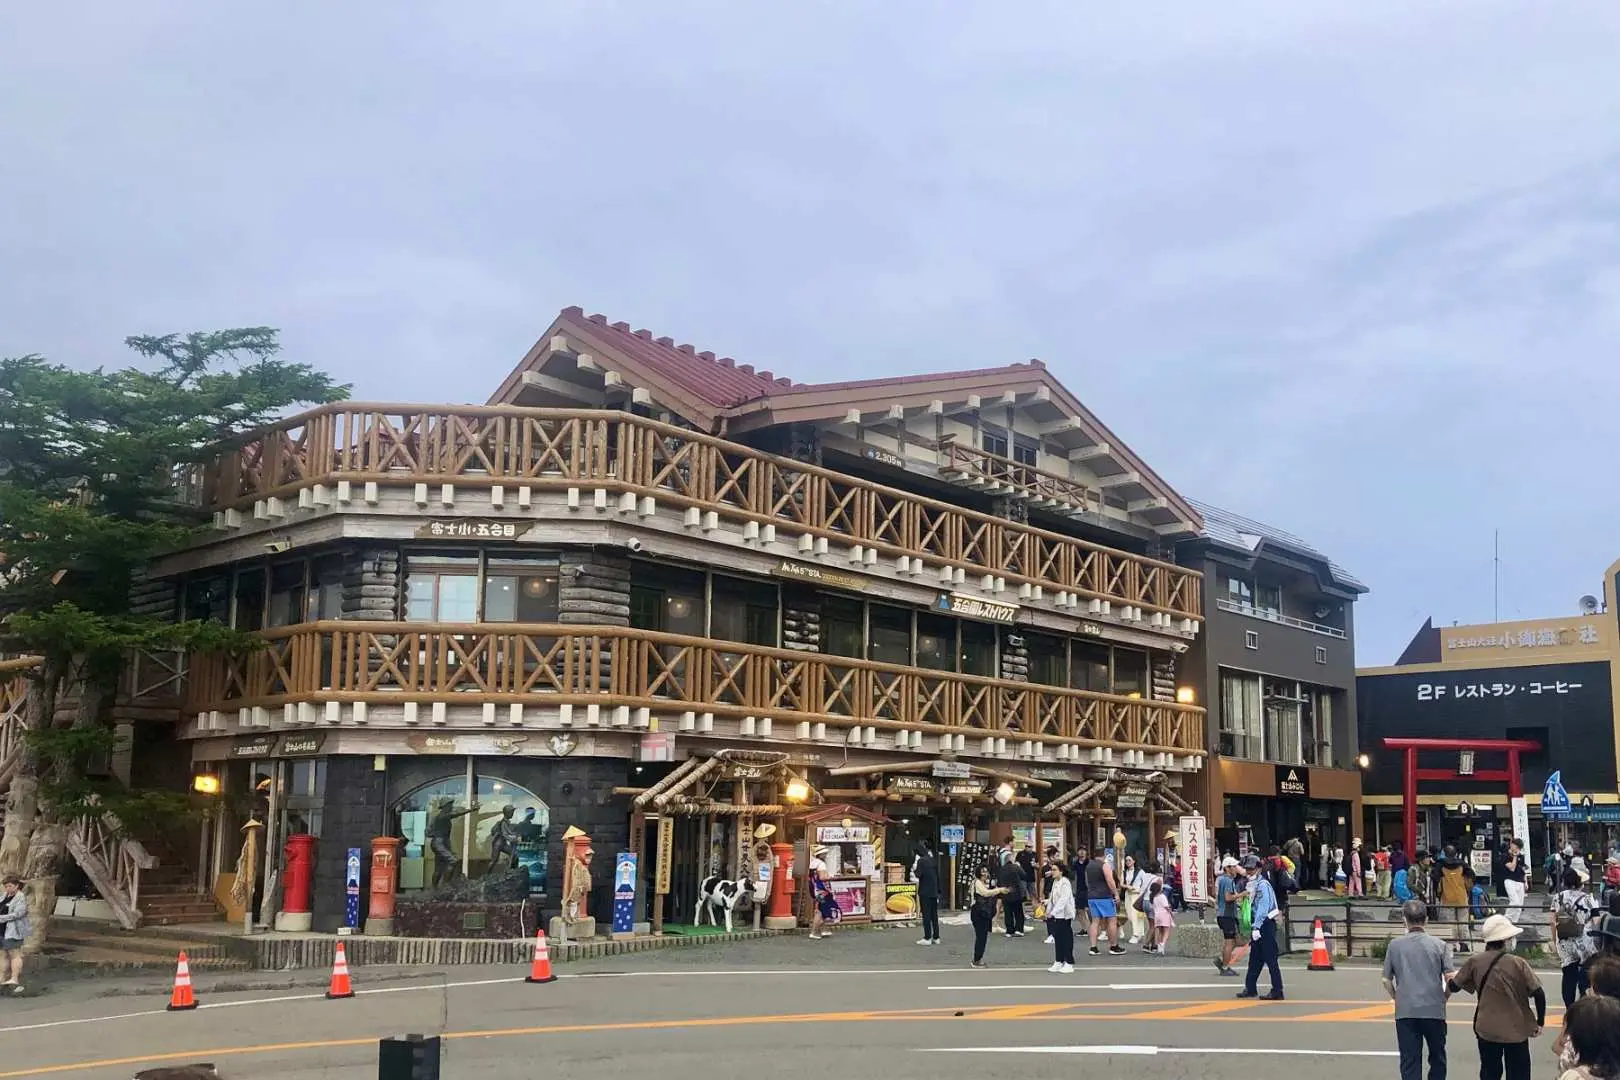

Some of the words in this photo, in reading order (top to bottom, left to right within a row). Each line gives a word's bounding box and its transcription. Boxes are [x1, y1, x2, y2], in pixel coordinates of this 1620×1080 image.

[1417, 684, 1447, 700] 2F
[1455, 681, 1583, 699] レストラン・コーヒー
[1461, 803, 1468, 814] B
[1583, 797, 1590, 806] A
[1188, 823, 1200, 898] バス進入禁止
